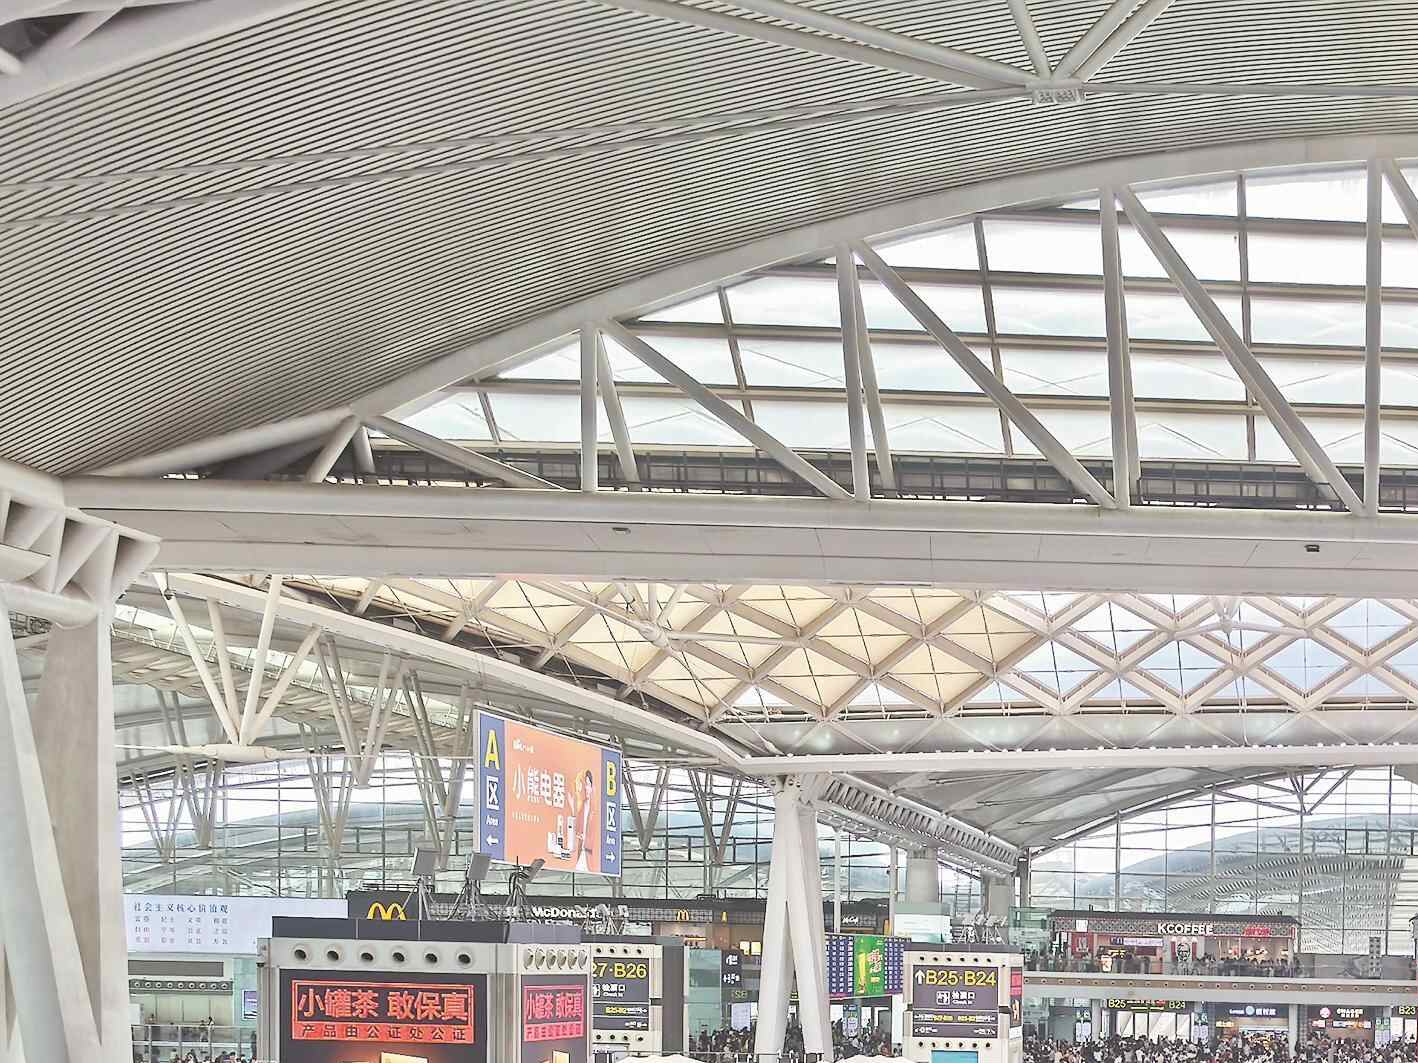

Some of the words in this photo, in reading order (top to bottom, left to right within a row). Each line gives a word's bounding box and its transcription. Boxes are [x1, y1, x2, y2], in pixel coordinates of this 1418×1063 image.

[484, 729, 500, 770] A
[486, 775, 500, 811] 区
[512, 764, 566, 809] 小熊电器
[606, 760, 617, 797] B
[606, 801, 617, 832] 区
[1157, 922, 1214, 935] KCOFFEE
[926, 969, 996, 987] B25·B24
[297, 987, 379, 1018] 小罐茶
[387, 990, 468, 1020] 敢保真
[301, 1024, 468, 1041] 产品由公证处公证
